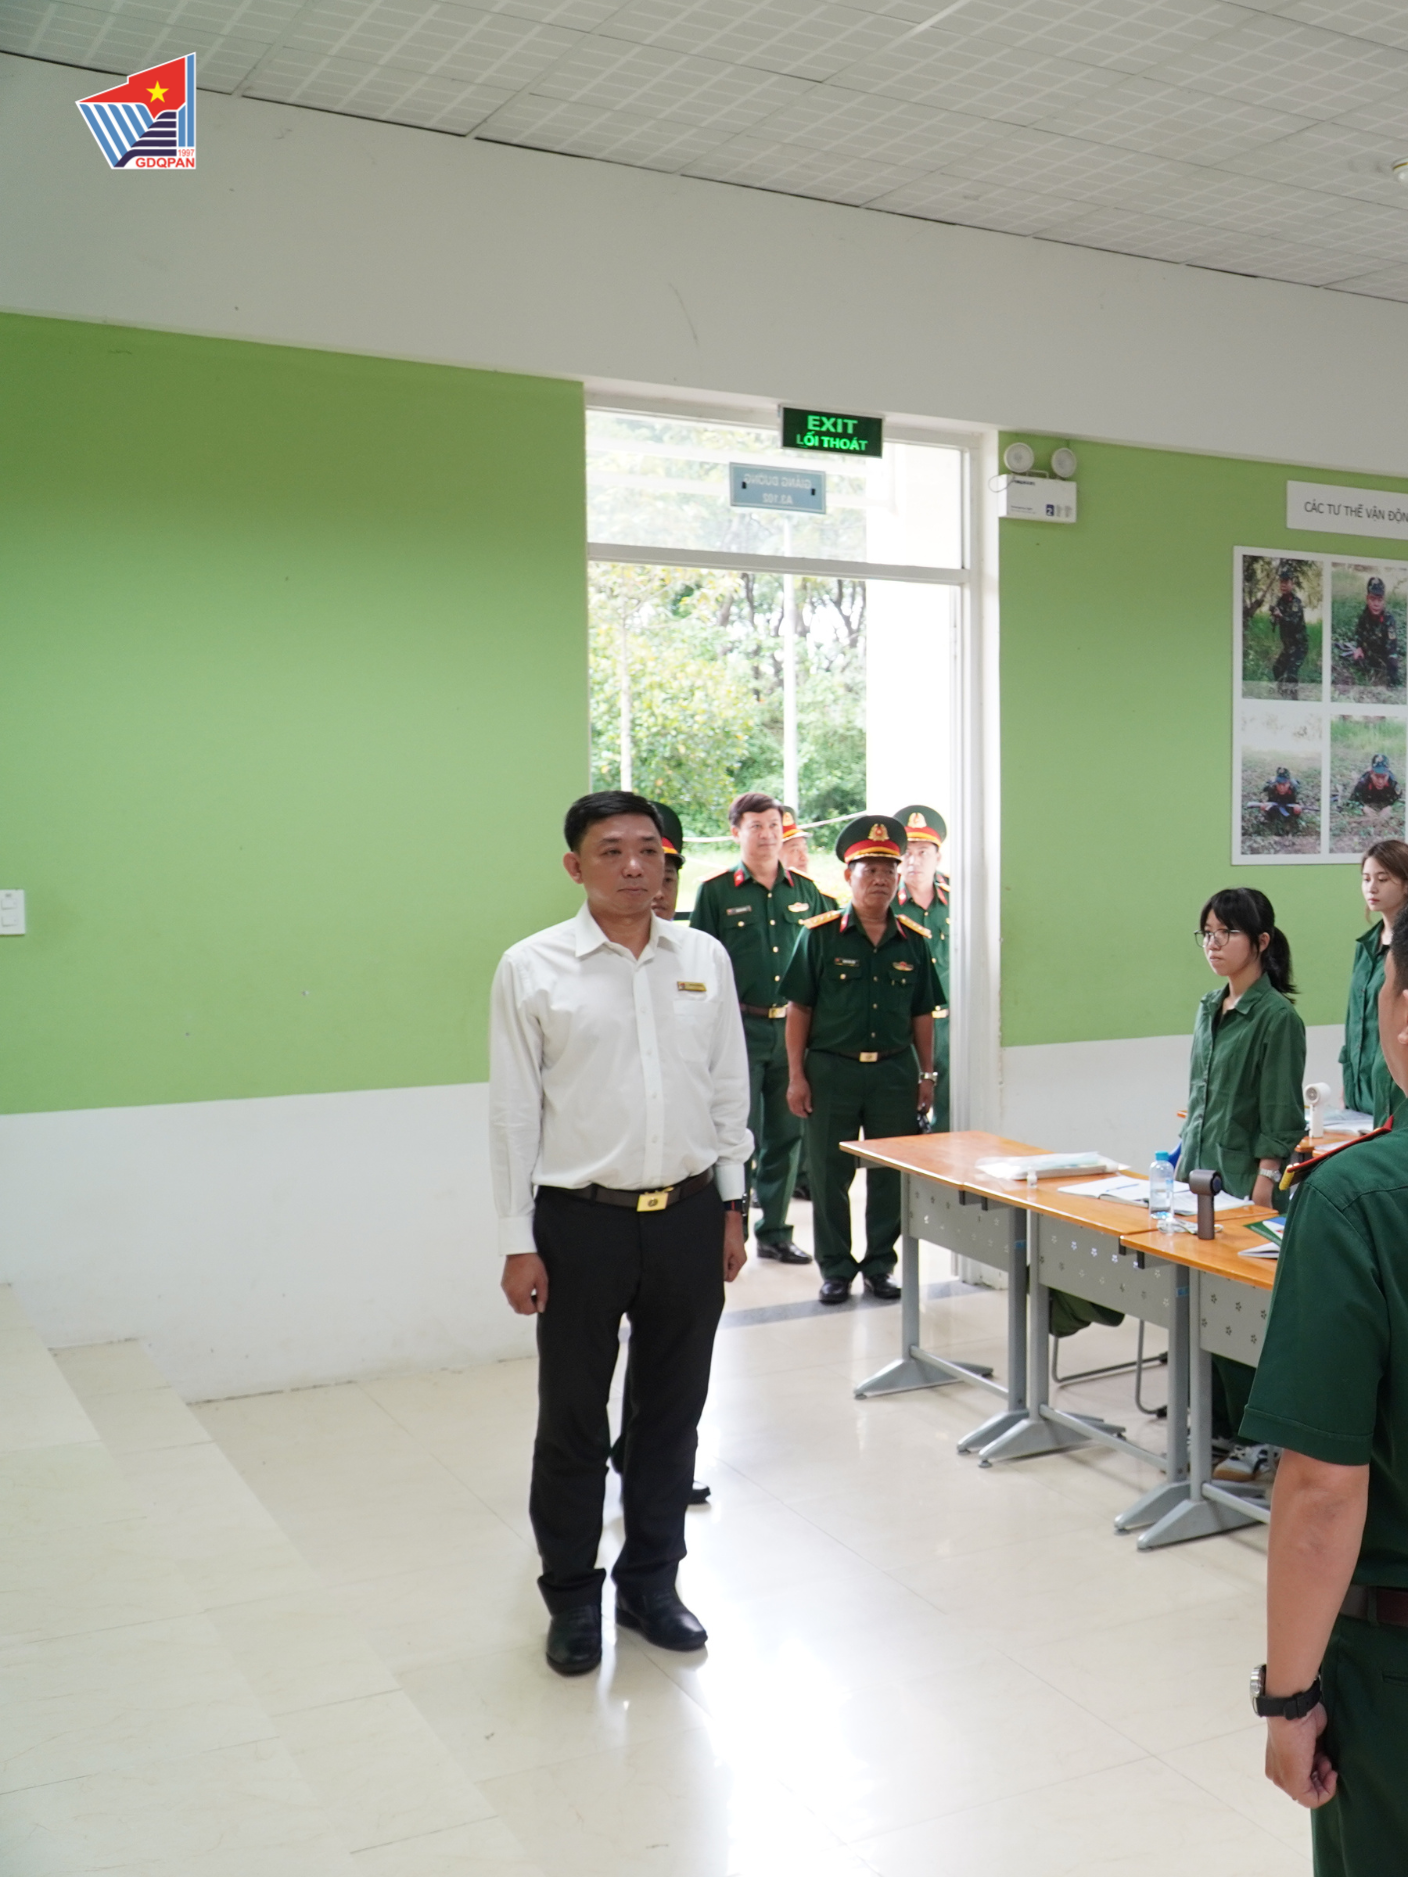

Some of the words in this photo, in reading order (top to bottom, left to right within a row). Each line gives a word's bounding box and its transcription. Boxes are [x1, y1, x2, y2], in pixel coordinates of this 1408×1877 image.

[807, 415, 858, 434] EXIT
[796, 431, 819, 447] LỐI
[820, 436, 868, 451] THOÁT
[1304, 499, 1324, 514] CÁC
[1327, 503, 1342, 516] TƯ
[1344, 504, 1364, 518] THẾ
[1366, 506, 1386, 521] VẬN
